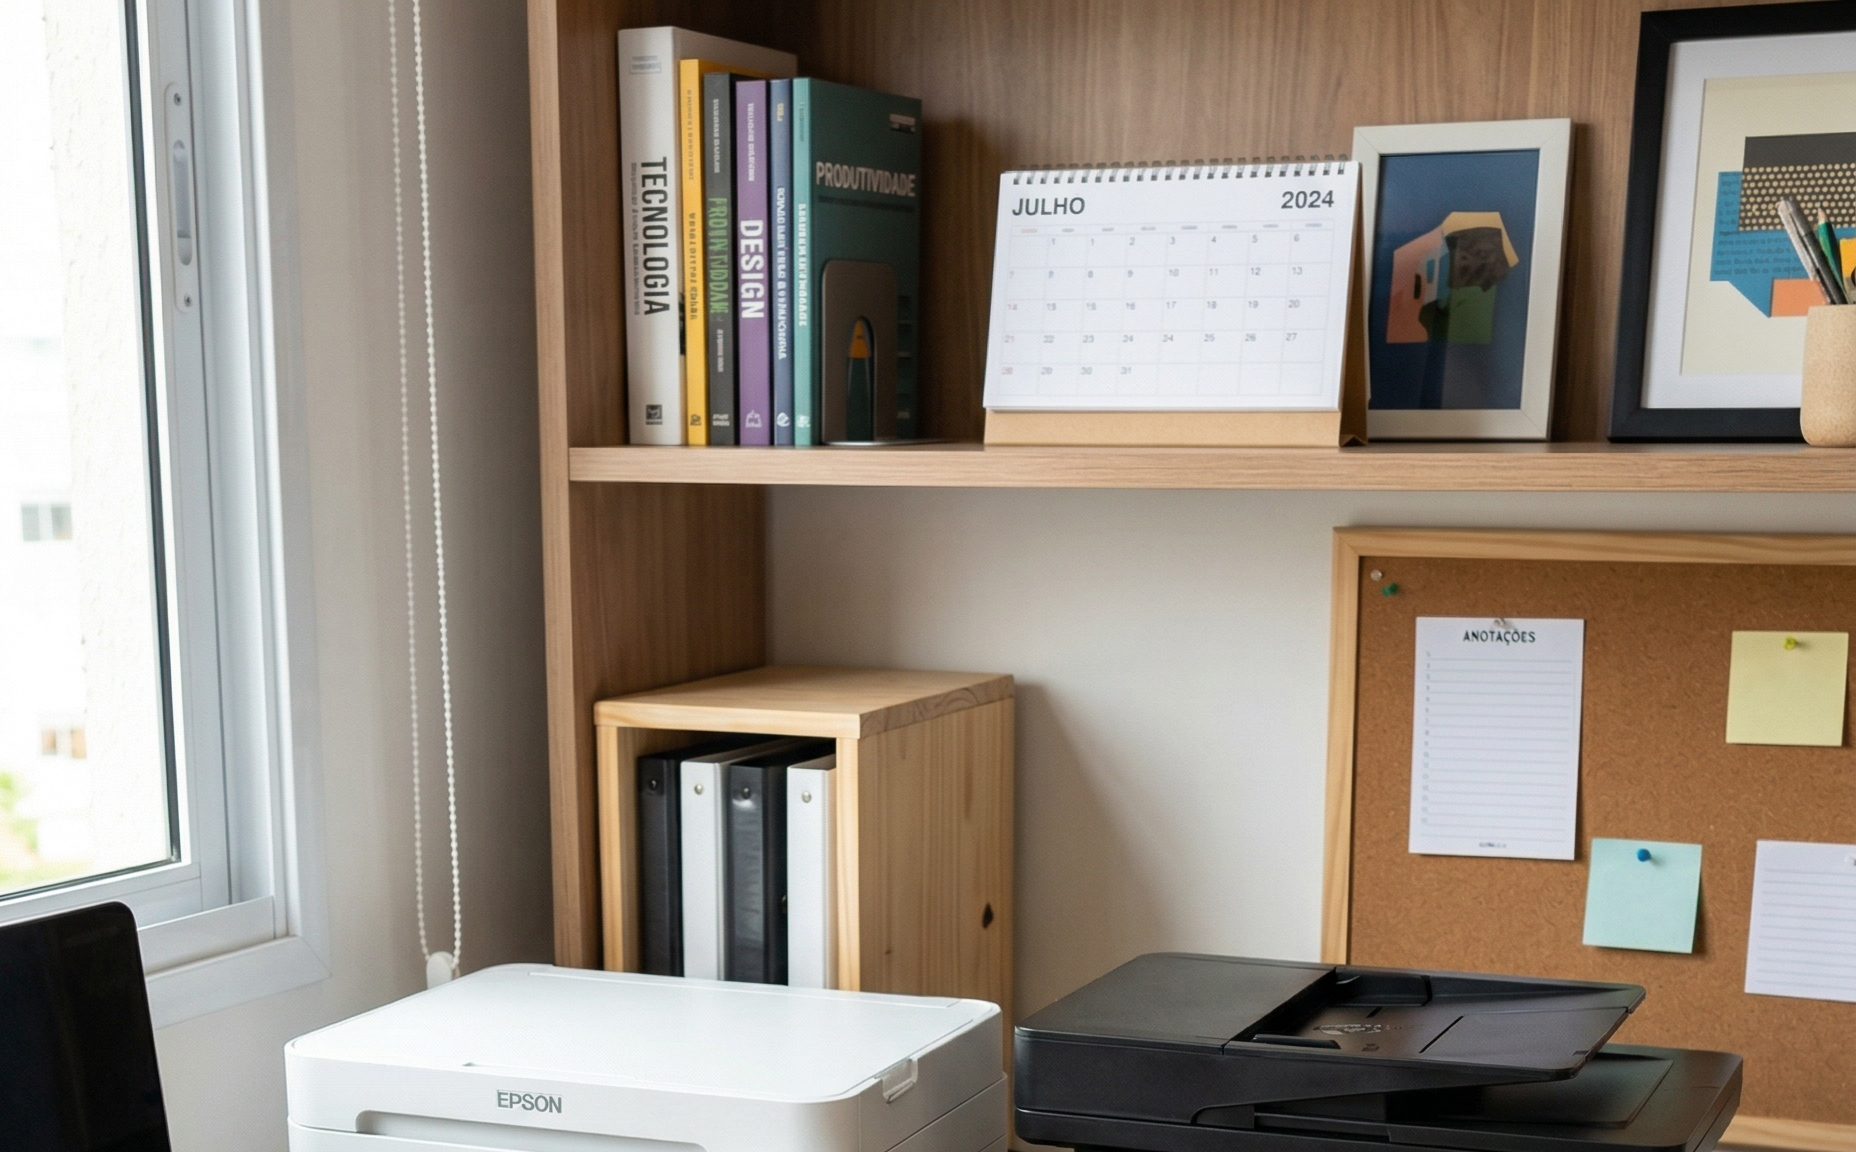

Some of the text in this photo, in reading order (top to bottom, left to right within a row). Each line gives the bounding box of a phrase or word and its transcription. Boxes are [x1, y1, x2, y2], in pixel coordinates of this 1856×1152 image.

[816, 162, 916, 197] PRODUTIVIDADE
[1012, 190, 1334, 215] JULHO 2024
[640, 156, 670, 316] TECNOLOGIA
[1129, 237, 1135, 245] 2
[1294, 234, 1299, 242] 6
[740, 220, 765, 318] DESIGN
[1209, 268, 1218, 276] 11
[1251, 268, 1261, 276] 12
[1292, 267, 1302, 275] 13
[1166, 301, 1176, 309] 17
[1288, 300, 1300, 308] 20
[1286, 333, 1297, 341] 27
[1462, 628, 1536, 646] ANOTAÇÕES
[498, 1091, 562, 1113] EPSON
